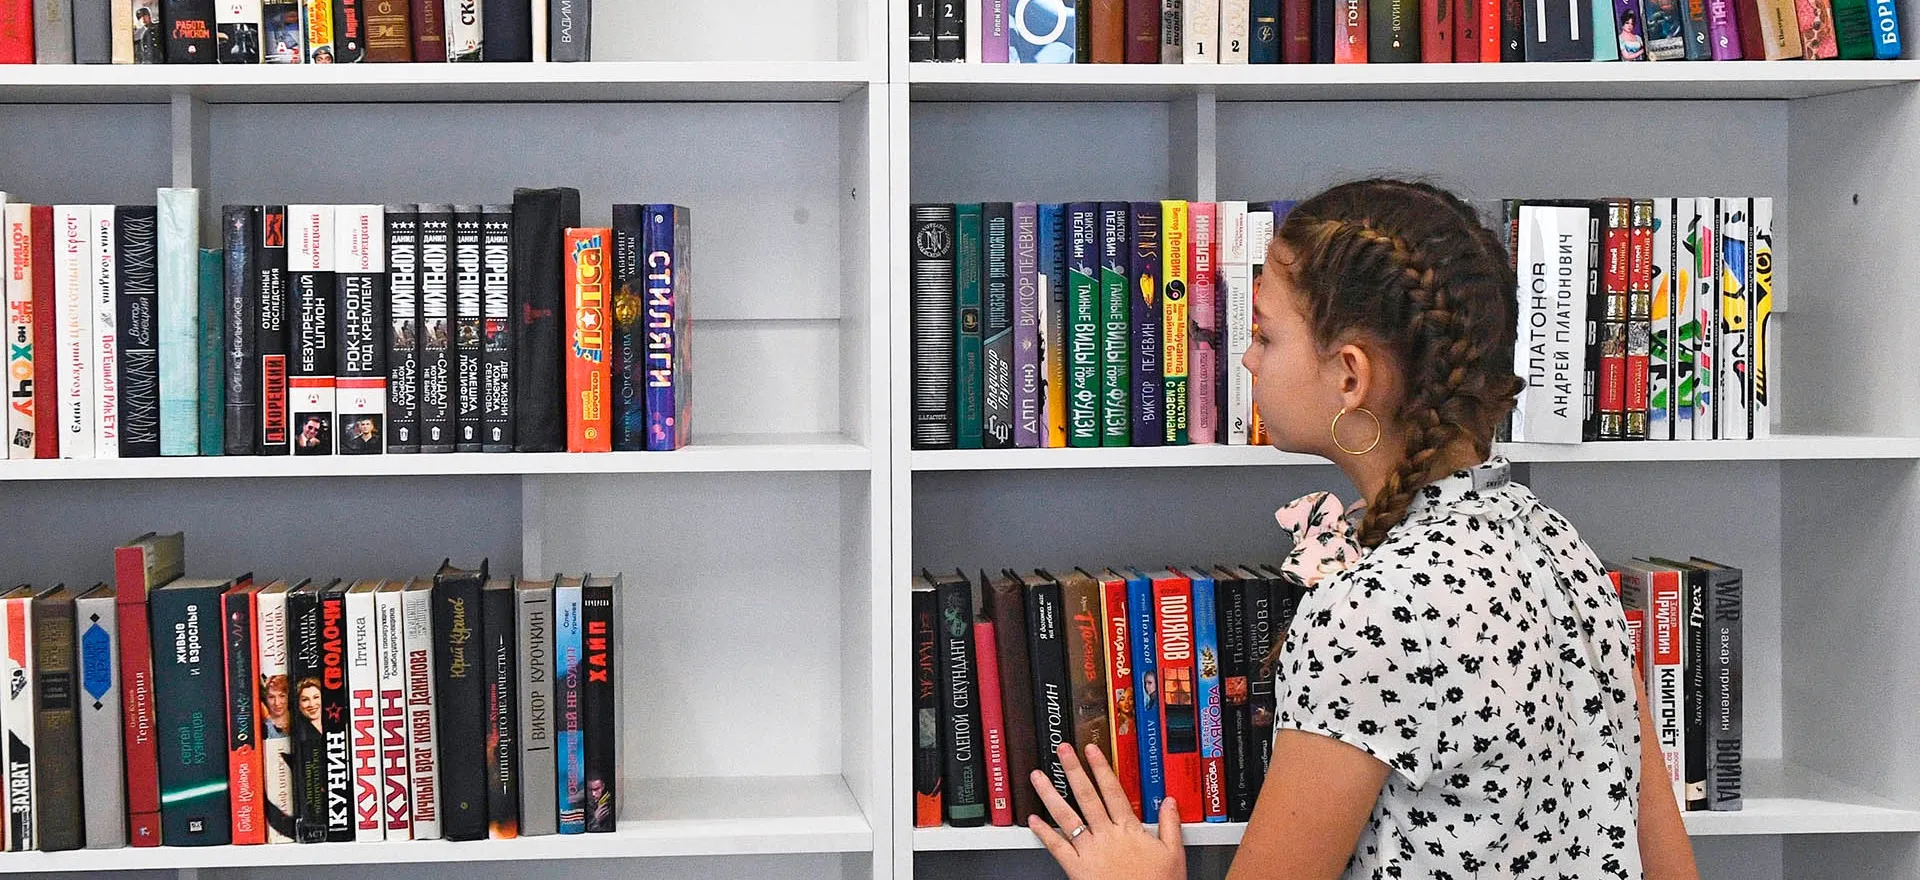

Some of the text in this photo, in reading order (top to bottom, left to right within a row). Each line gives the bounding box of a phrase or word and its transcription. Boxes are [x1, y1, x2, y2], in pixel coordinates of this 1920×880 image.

[176, 20, 206, 30] РАБОТА
[561, 1, 572, 43] ВАДИМ
[916, 4, 923, 17] 1
[945, 4, 953, 17] 2
[1438, 32, 1445, 40] 1
[1465, 29, 1472, 38] 2
[1196, 43, 1204, 54] 1
[1231, 40, 1240, 52] 2
[310, 213, 321, 269] КОРЕЦКИЙ
[359, 214, 369, 270] КОРЕЦКИЙ
[1074, 212, 1085, 257] ПЕЛЕВИН
[1085, 212, 1094, 244] ВИКТОР
[1106, 210, 1116, 256] ПЕЛЕВИН
[1116, 210, 1125, 242] ВИКТОР
[390, 244, 415, 318] КОРЕЦКИЙ
[423, 243, 447, 317] КОРЕЦКИЙ
[457, 244, 479, 317] КОРЕЦКИЙ
[485, 244, 509, 318] КОРЕЦКИЙ
[617, 230, 626, 281] ЛАБИРИНТ
[627, 236, 635, 275] МЕДУЗЫ
[988, 217, 1008, 328] приказано уничтожить
[1019, 216, 1034, 326] ВИКТОР ПЕЛЕВИН
[1169, 232, 1183, 277] Пелевин
[1196, 215, 1209, 312] ВИКТОР ПЕЛЕВИН
[1642, 238, 1650, 281] ПЛАТОНОВ
[128, 302, 139, 337] Виктор
[139, 296, 151, 346] Конецкий
[262, 270, 270, 329] ОТДАЛЕННЫЕ
[271, 268, 280, 331] ПОСЛЕДСТВИЯ
[301, 275, 314, 372] БЕЗУПРЕЧНЫЙ
[315, 297, 326, 349] ШПИОН
[347, 277, 359, 372] РОК-Н-РОЛЛ
[361, 277, 374, 371] ПОД КРЕМЛЕМ
[648, 251, 671, 388] СТИЛЯГИ
[1074, 283, 1095, 364] ТАЙНЫЕ ВИДЫ
[1105, 282, 1127, 363] ТАЙНЫЕ ВИДЫ
[1529, 262, 1547, 388] ПЛАТОНОВ
[1553, 234, 1573, 418] АНДРЕЙ ПЛАТОНОВИЧ
[11, 343, 33, 417] ХОЧУ
[459, 354, 468, 415] ЛЮЦИФЕРА
[469, 357, 477, 412] УСМЕШКА
[621, 333, 633, 405] КОРСАКОВА
[986, 348, 998, 410] Владимир
[998, 359, 1010, 410] Паутов
[1075, 367, 1086, 388] ГОРУ
[1086, 367, 1095, 377] НА
[1106, 365, 1117, 387] ГОРУ
[1141, 323, 1155, 421] ВИКТОР ПЕЛЕВИН
[1166, 345, 1174, 373] битва
[492, 365, 500, 410] КОМЭСКА
[499, 360, 508, 415] ДВЕ ЖИЗНИ
[1074, 390, 1096, 437] ФУДЗИ
[1105, 388, 1127, 436] ФУДЗИ
[1165, 389, 1177, 441] масонами
[1177, 381, 1186, 428] чекистов
[1023, 398, 1036, 434] ДПП
[1160, 595, 1190, 660] ПОЛЯКОВ
[1656, 591, 1678, 654] ПРИЛЕПИН
[1715, 578, 1741, 622] WAR
[174, 623, 187, 664] живые
[187, 604, 202, 663] взрослые
[324, 600, 343, 690] СВОЛОЧИ
[355, 616, 369, 667] Птичка
[586, 621, 607, 682] ХАЙП
[1112, 602, 1131, 678] Поляков
[1142, 614, 1153, 664] Поляков
[1225, 610, 1234, 650] Татьяна
[1233, 595, 1244, 663] Полякова
[1249, 624, 1257, 663] Татьяна
[1690, 585, 1705, 725] Захар Прилепин Грех
[408, 649, 433, 706] Данилова
[449, 647, 471, 678] Юрий
[498, 645, 508, 735] ЕГО ВЕЛИЧЕСТВА
[530, 610, 546, 740] ВИКТОР КУРОЧКИН
[1718, 627, 1730, 730] захар прилепин
[135, 672, 149, 744] Территория
[411, 710, 431, 744] князя
[950, 639, 972, 762] СЛЕПОЙ СЕКУНДАНТ
[1202, 707, 1210, 749] ТАТЬЯНА
[1661, 668, 1679, 747] КНИГОЧЁТ
[354, 689, 378, 830] КУНИН
[381, 689, 408, 830] КУНИН
[412, 747, 434, 773] враг
[989, 729, 1001, 763] ПОГОДИН
[1147, 719, 1160, 784] АПОФЕГЕЙ
[1716, 739, 1741, 801] ВОЙНА
[11, 761, 31, 813] ЗАХВАТ
[328, 731, 346, 826] КУНИН
[415, 776, 435, 822] Личный
[1209, 760, 1220, 813] ПОЛЯКОВА
